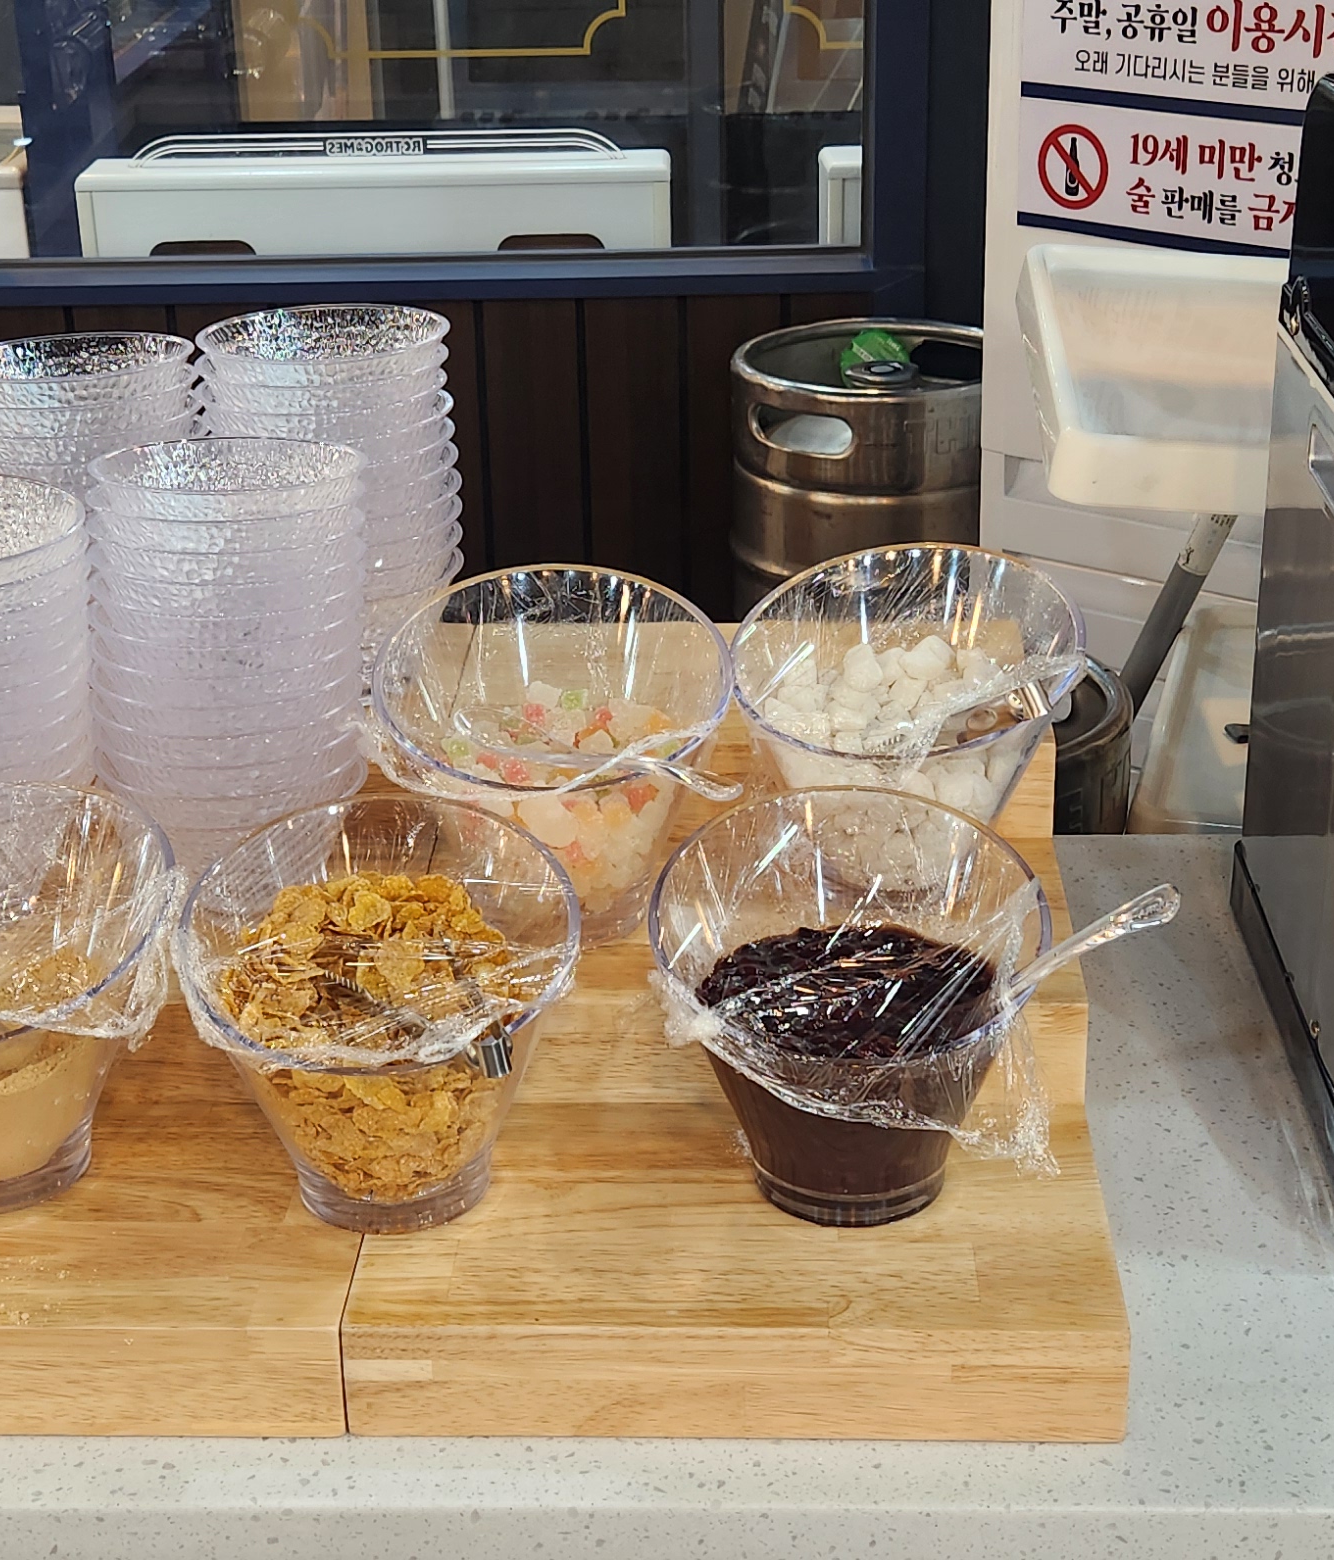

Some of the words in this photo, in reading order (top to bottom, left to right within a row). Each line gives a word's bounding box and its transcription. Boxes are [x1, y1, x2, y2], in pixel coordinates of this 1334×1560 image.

[1074, 49, 1109, 75] 오래
[1114, 51, 1206, 85] 기다리시는
[1212, 61, 1270, 91] 분들을
[1276, 67, 1316, 94] 위해
[1129, 132, 1188, 176] 19세
[1198, 138, 1263, 182] 미만
[1267, 151, 1299, 186] 청
[1125, 176, 1156, 215] 술
[1161, 186, 1242, 227] 판매를
